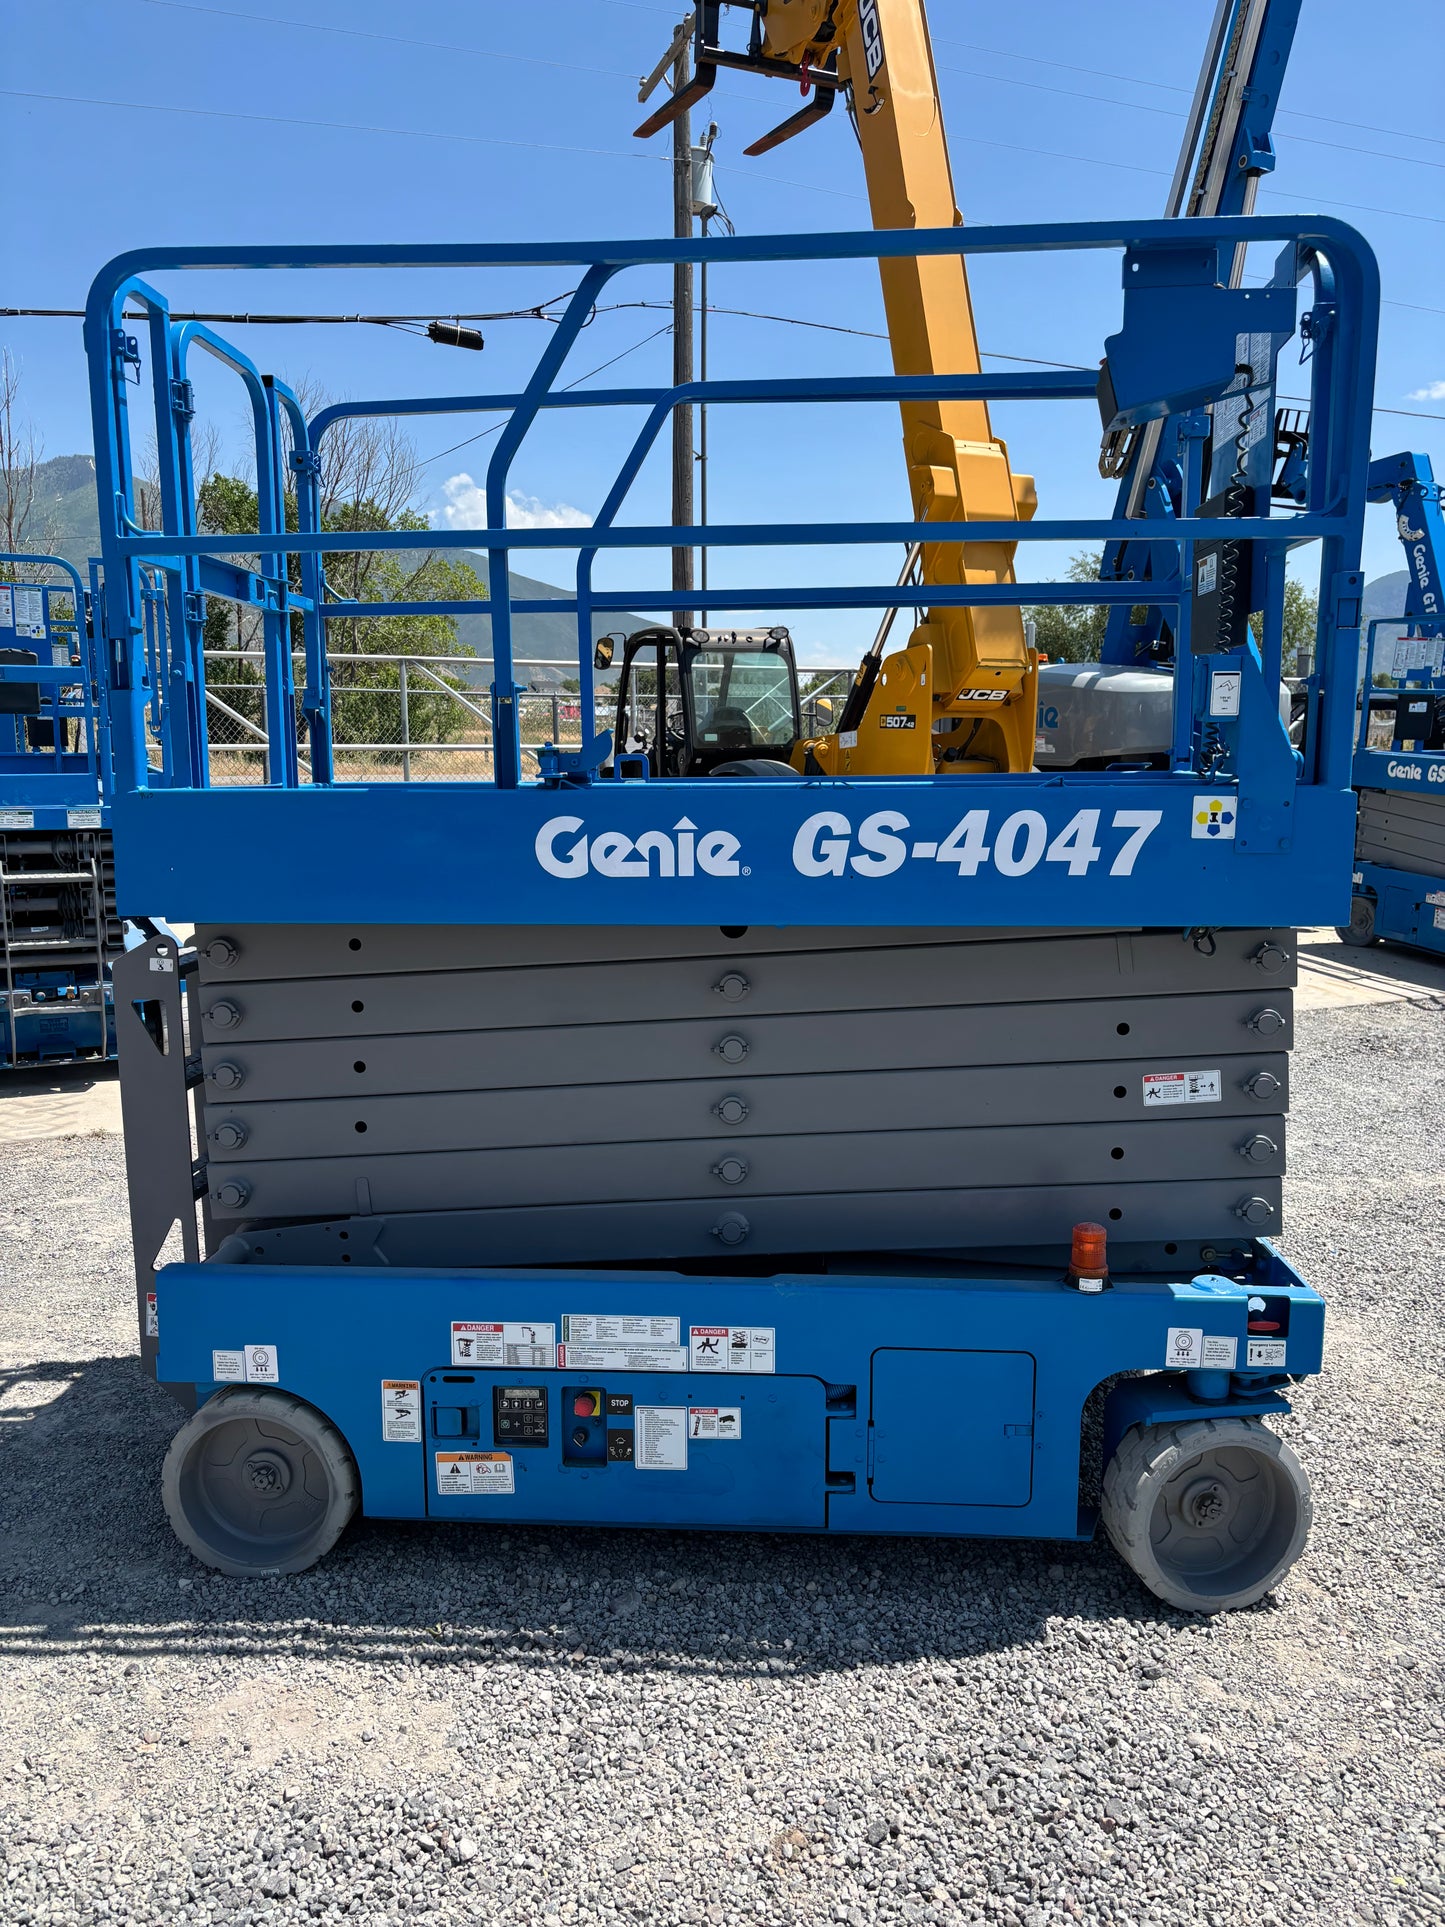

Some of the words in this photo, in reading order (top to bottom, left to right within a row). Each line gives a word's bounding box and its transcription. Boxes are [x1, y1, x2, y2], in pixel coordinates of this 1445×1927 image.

[1413, 544, 1430, 590] Genie
[958, 689, 1008, 700] JCB
[886, 716, 915, 728] 507-42
[1387, 760, 1422, 781] Genie
[791, 809, 1163, 877] GS-4047
[611, 1399, 629, 1407] STOP
[465, 1453, 493, 1461] WARNING
